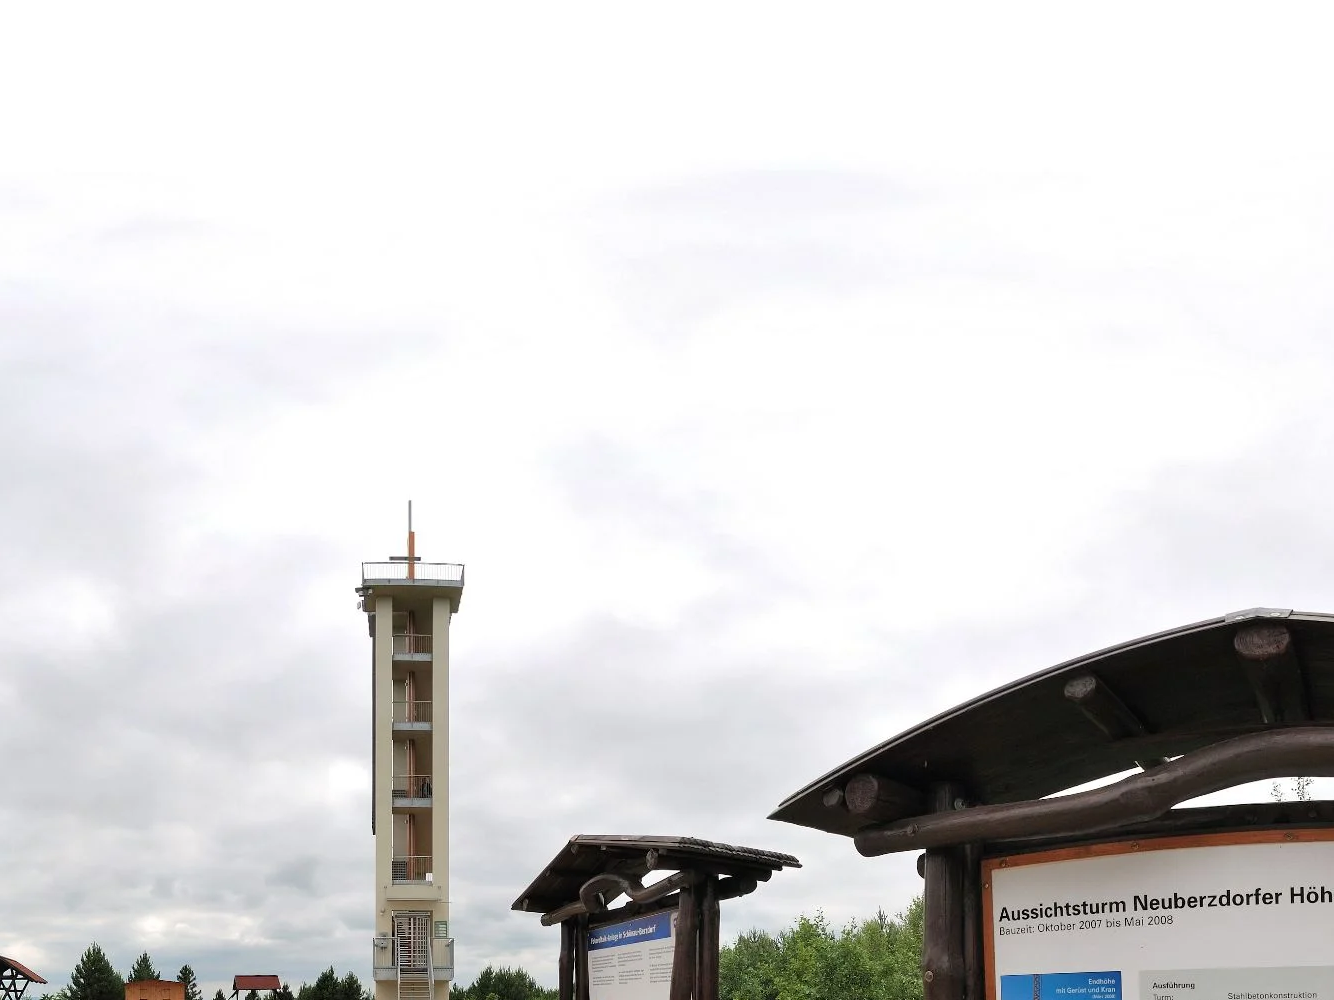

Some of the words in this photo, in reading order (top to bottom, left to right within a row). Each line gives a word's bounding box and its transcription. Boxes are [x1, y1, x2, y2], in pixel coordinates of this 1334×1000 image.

[999, 898, 1126, 922] Aussichtsturm
[1133, 888, 1282, 911] Neuberzdorfer
[999, 924, 1035, 936] Bauzeit:
[1037, 921, 1076, 933] Oktober
[1079, 919, 1102, 930] 2007
[1106, 918, 1121, 928] bis
[1124, 916, 1144, 927] Mai
[1148, 915, 1173, 925] 2008
[1152, 982, 1195, 990] Ausführung
[1227, 992, 1317, 1000] Stahlbetonkonstruktion
